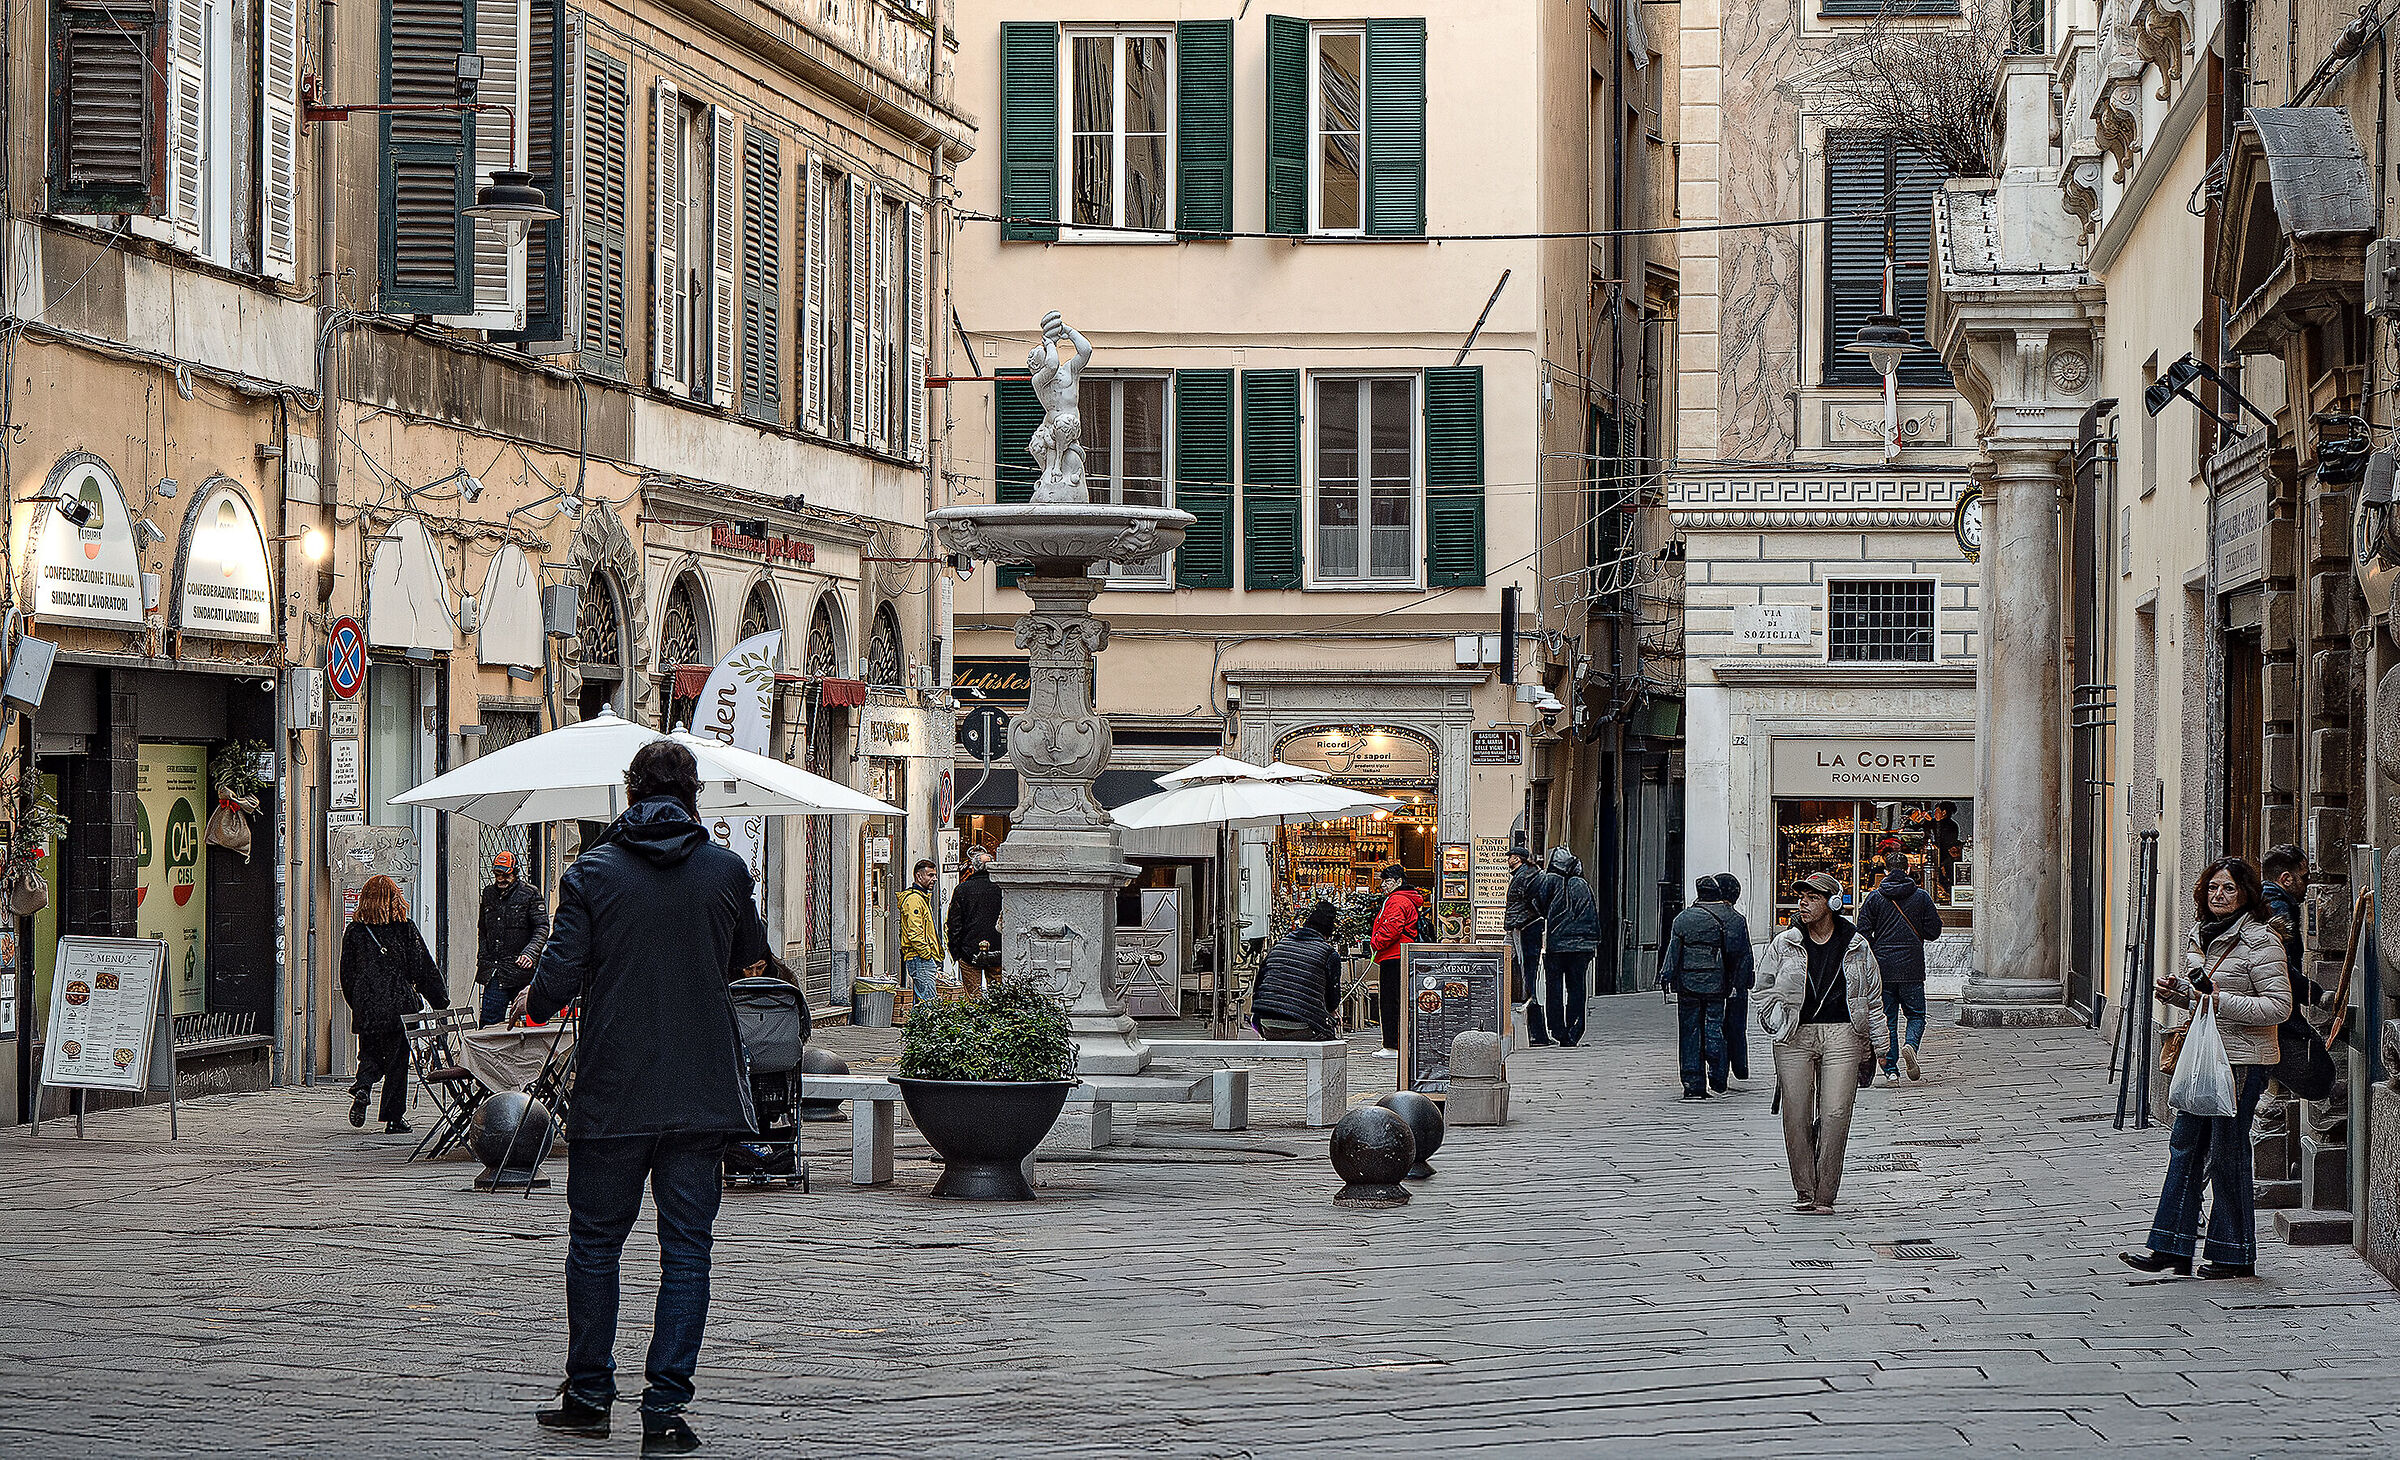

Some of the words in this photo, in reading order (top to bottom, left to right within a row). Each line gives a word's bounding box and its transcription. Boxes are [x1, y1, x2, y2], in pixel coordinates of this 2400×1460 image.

[44, 565, 104, 585] CONFEDERAZIONE
[105, 572, 135, 589] ITALIANA
[51, 590, 87, 608] SINDACATI
[88, 595, 128, 612] LAVORATORI
[187, 582, 239, 600] CONFEDERAZIONE
[239, 588, 265, 603] ITALIANA
[193, 605, 224, 621] SINDACATI
[224, 609, 260, 625] LAVORATORI
[1744, 631, 1801, 639] SOZIGLIA
[705, 683, 737, 747] den
[1317, 740, 1350, 749] Ricordi
[1735, 737, 1746, 745] 72
[1363, 752, 1391, 761] sapori
[1857, 751, 1936, 768] CORTE
[1831, 773, 1920, 783] ROMANENGO
[744, 815, 762, 839] Ri
[171, 821, 198, 862] CAF
[177, 867, 194, 885] CISL
[96, 953, 125, 964] MENU
[1443, 964, 1471, 974] MENU
